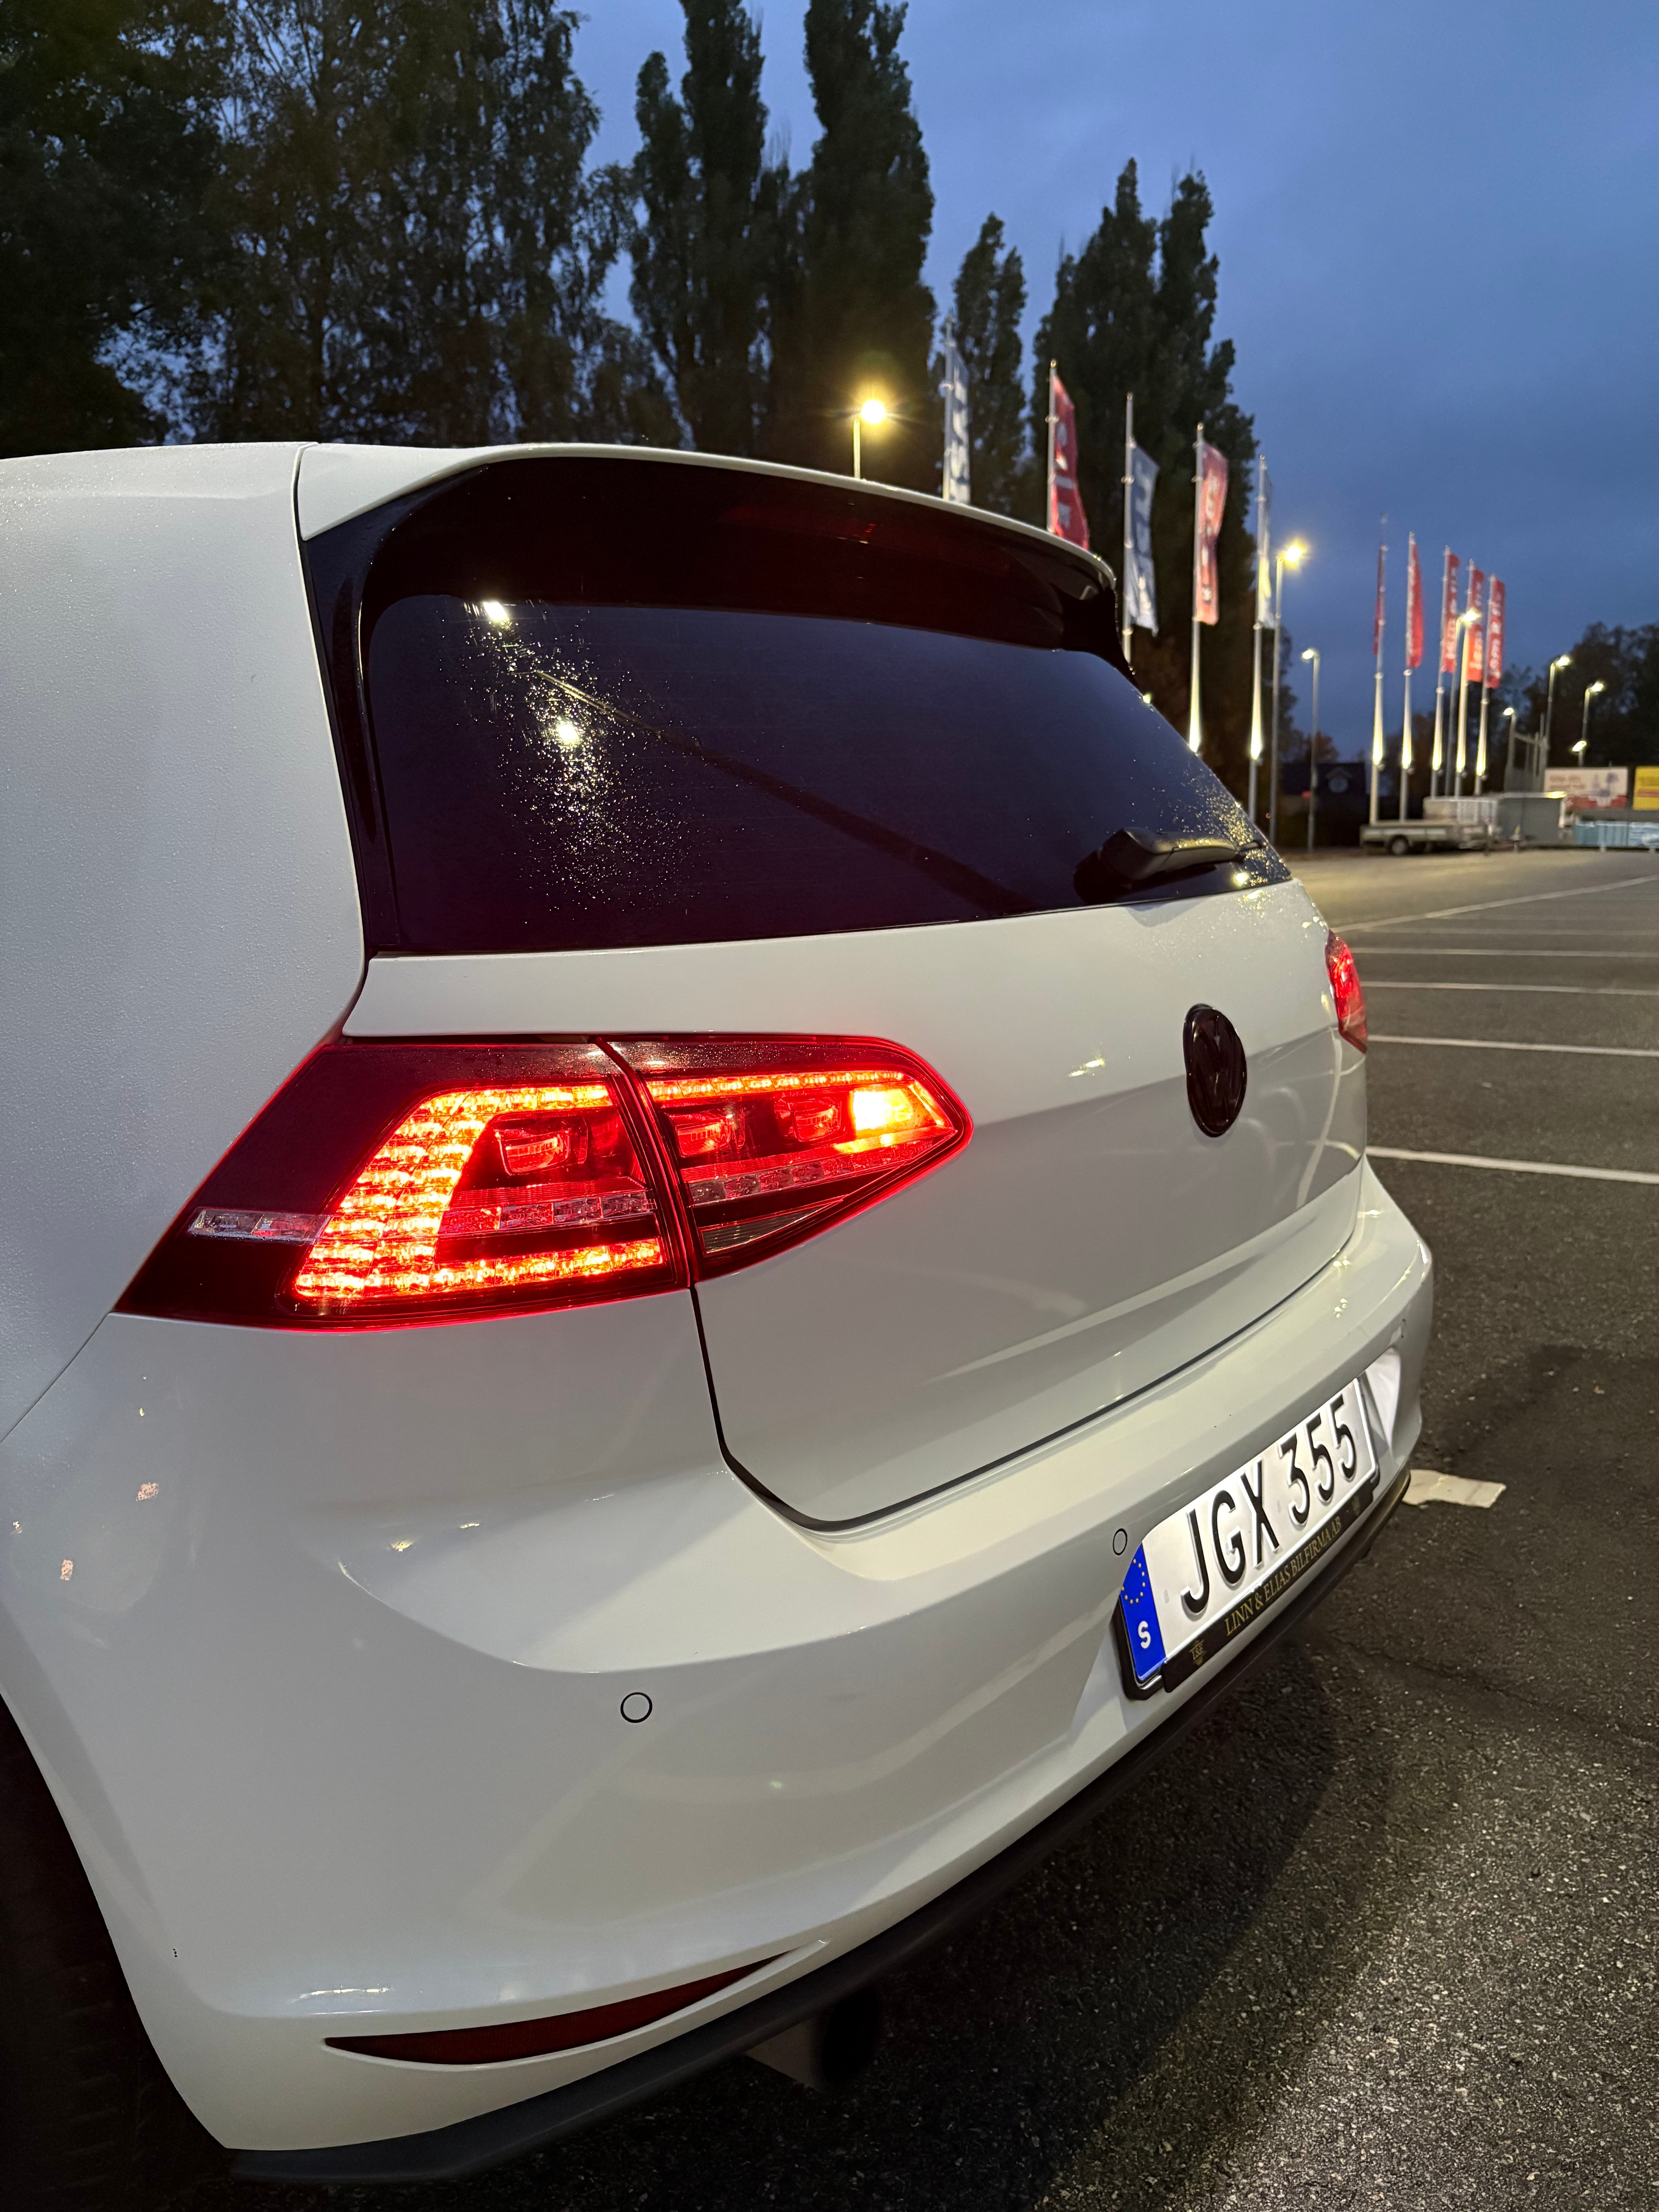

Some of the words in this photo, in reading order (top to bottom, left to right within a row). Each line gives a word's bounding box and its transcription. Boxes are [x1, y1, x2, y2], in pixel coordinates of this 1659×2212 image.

[1182, 1457, 1279, 1613] JGX
[1279, 1394, 1356, 1524] 355
[1138, 1621, 1151, 1649] S
[1224, 1598, 1254, 1636] LINN
[1255, 1592, 1264, 1610] &
[1263, 1565, 1291, 1602] ELIAS
[1290, 1528, 1331, 1577] BILFIRMA
[1331, 1516, 1342, 1538] AB
